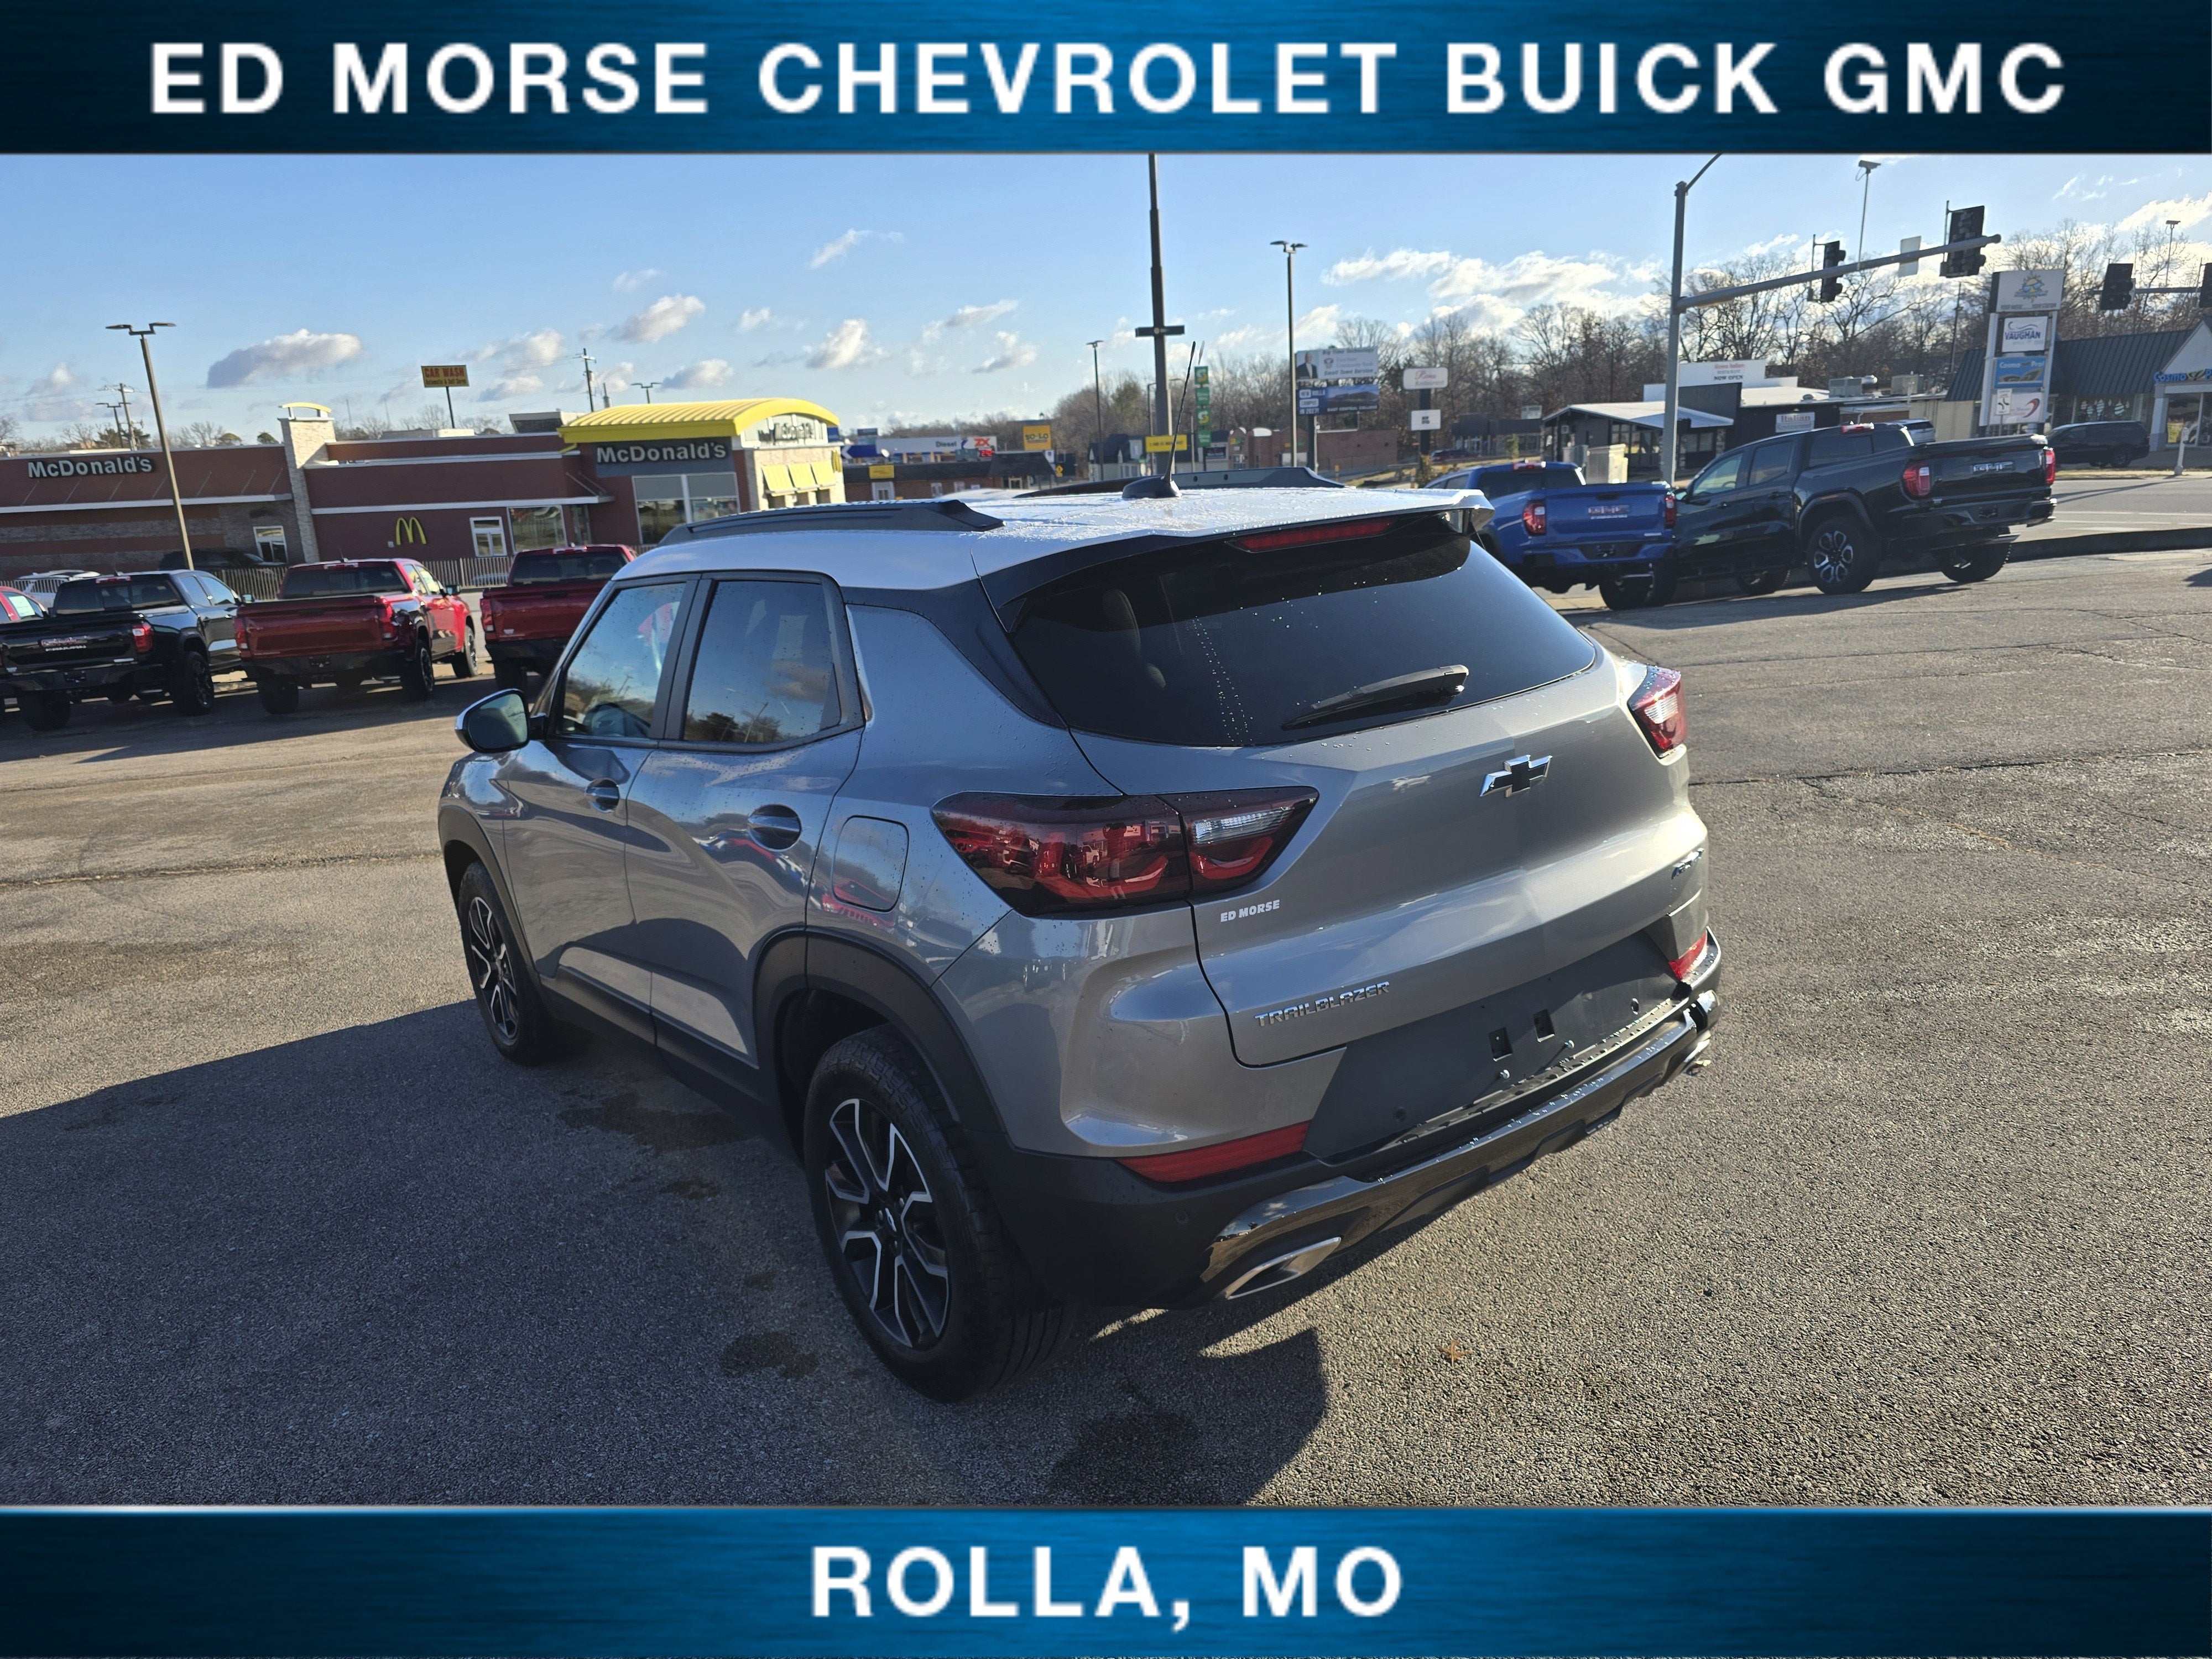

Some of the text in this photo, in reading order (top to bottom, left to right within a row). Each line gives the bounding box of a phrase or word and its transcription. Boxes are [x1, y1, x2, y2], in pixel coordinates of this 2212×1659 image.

[2005, 331, 2041, 340] VAUGHAN
[424, 367, 465, 378] CAR WASH
[2154, 371, 2187, 383] Cosmo
[597, 441, 727, 463] McDonald's
[28, 456, 153, 478] McDonald's
[1220, 899, 1280, 922] ED MORSE
[1254, 980, 1390, 1027] TRAILBLAZER
